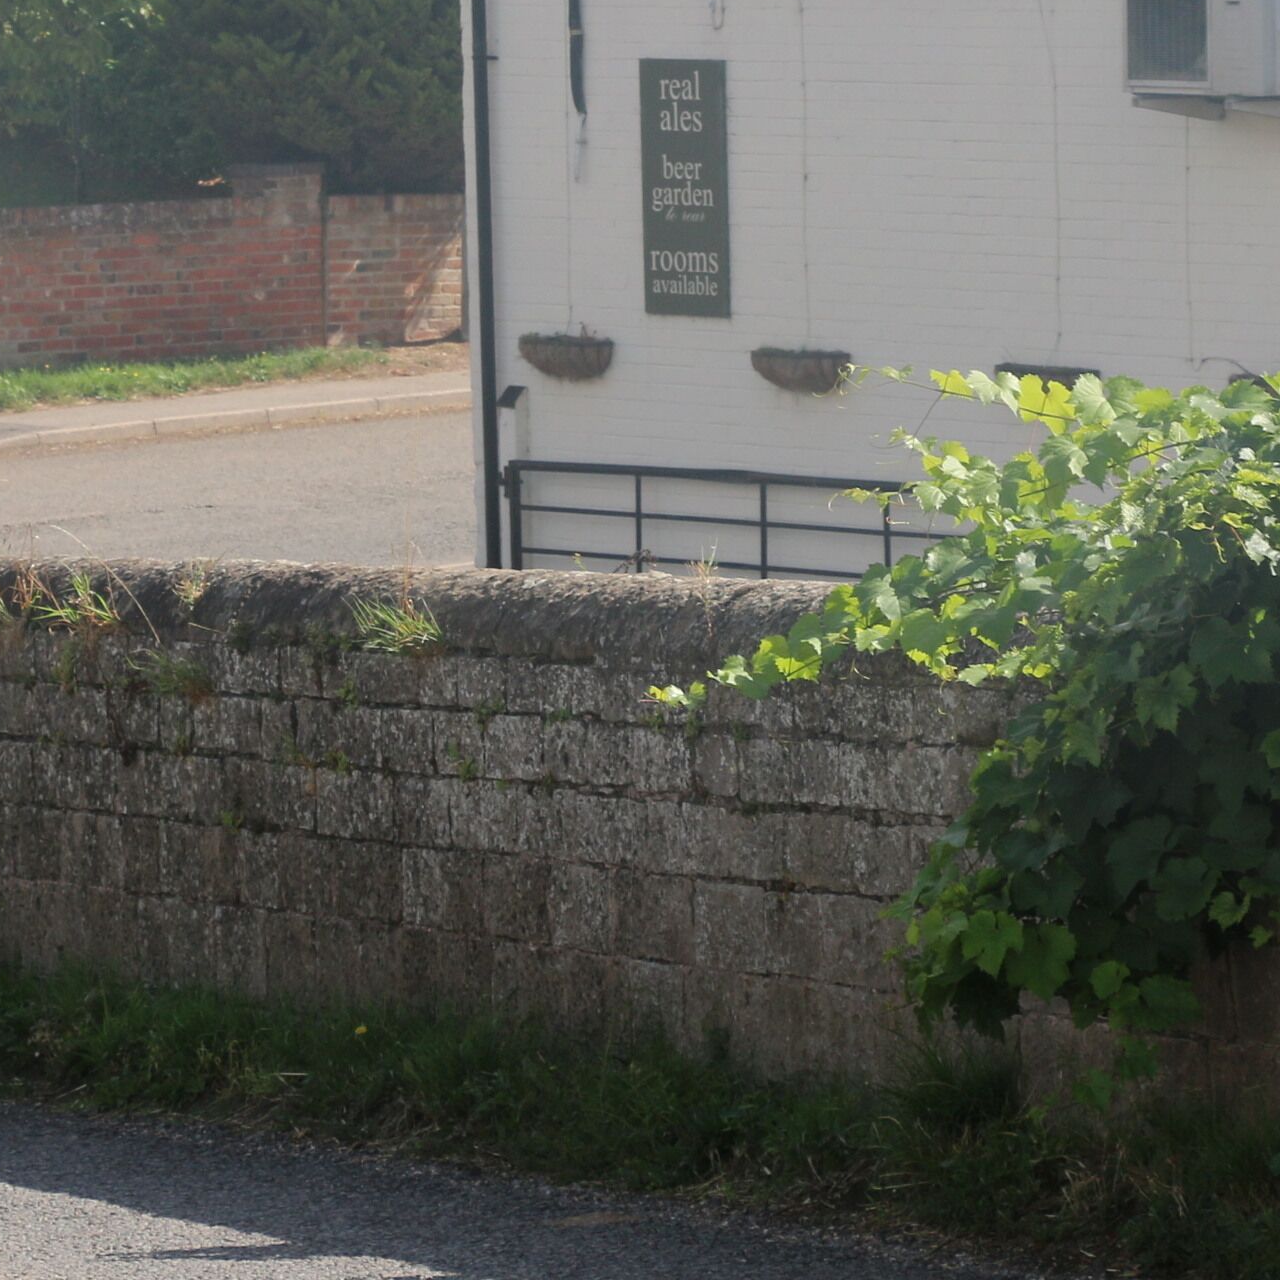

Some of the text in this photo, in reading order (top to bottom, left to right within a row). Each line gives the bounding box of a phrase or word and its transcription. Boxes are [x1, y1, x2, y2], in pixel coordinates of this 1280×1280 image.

[659, 71, 701, 100] real
[660, 102, 703, 132] ales
[662, 154, 703, 180] beer
[652, 181, 714, 212] garden
[650, 249, 719, 273] rooms
[652, 274, 718, 297] available
